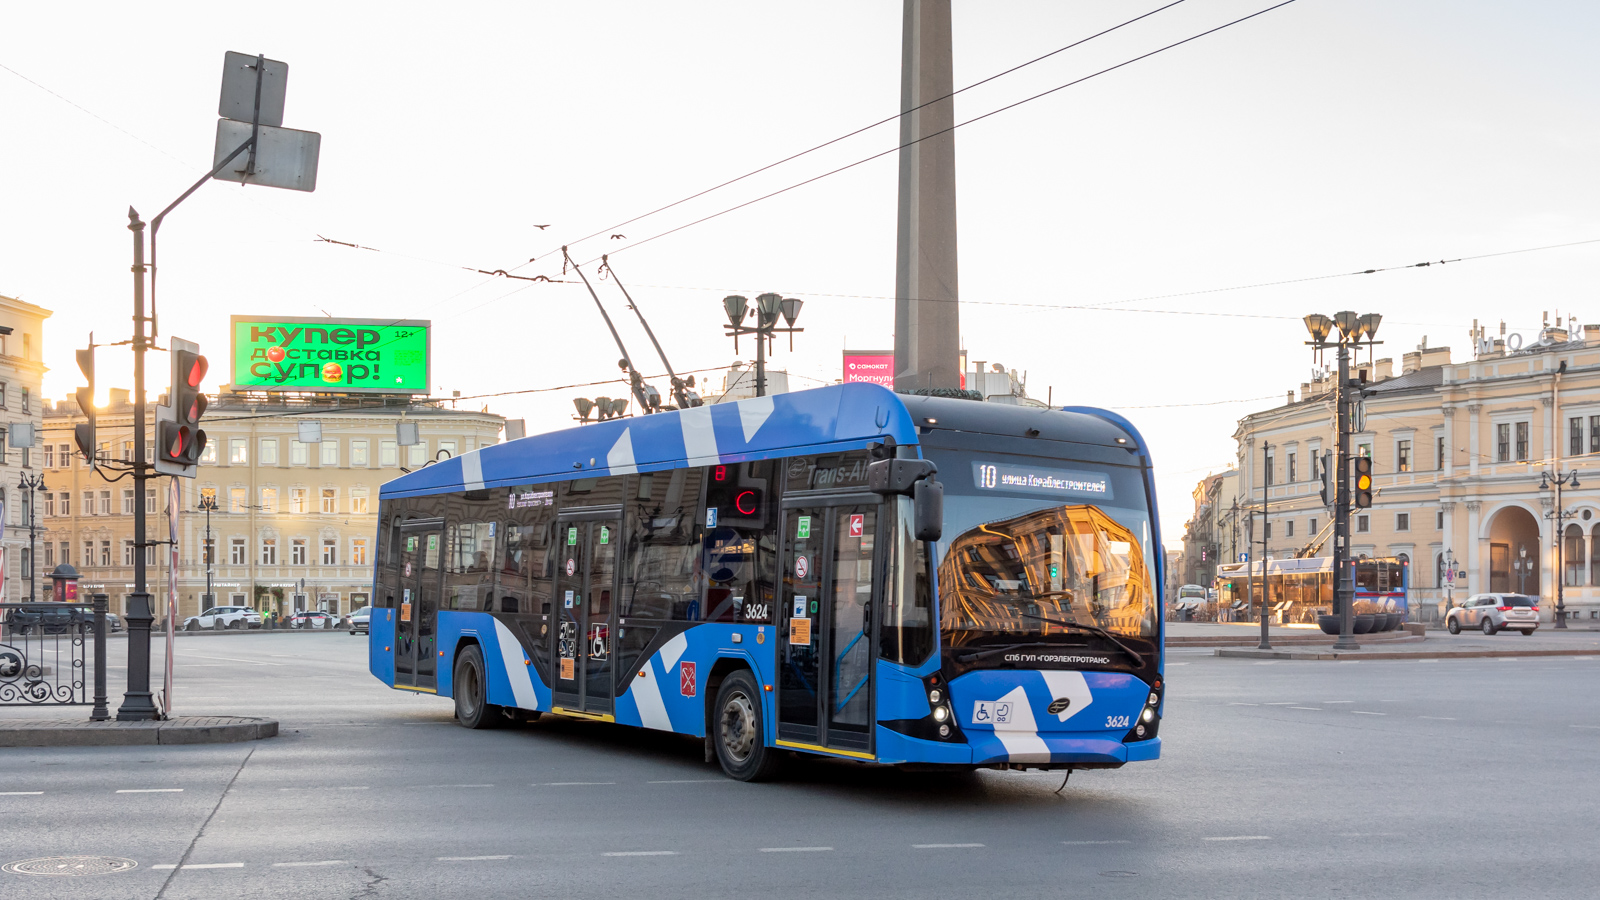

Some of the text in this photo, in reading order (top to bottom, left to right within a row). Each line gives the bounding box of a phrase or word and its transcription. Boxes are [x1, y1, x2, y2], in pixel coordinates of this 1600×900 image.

[251, 326, 381, 349] купер
[1477, 324, 1583, 355] МОСК
[250, 346, 381, 362] дставка
[250, 362, 381, 385] супр!
[979, 464, 1106, 493] 10 улица Кораблестроителей
[745, 603, 768, 620] 3624
[1004, 654, 1110, 664] СПб ГУП «ГОРЭЛЕКТРОТРАНС»
[1105, 715, 1130, 728] 3624
